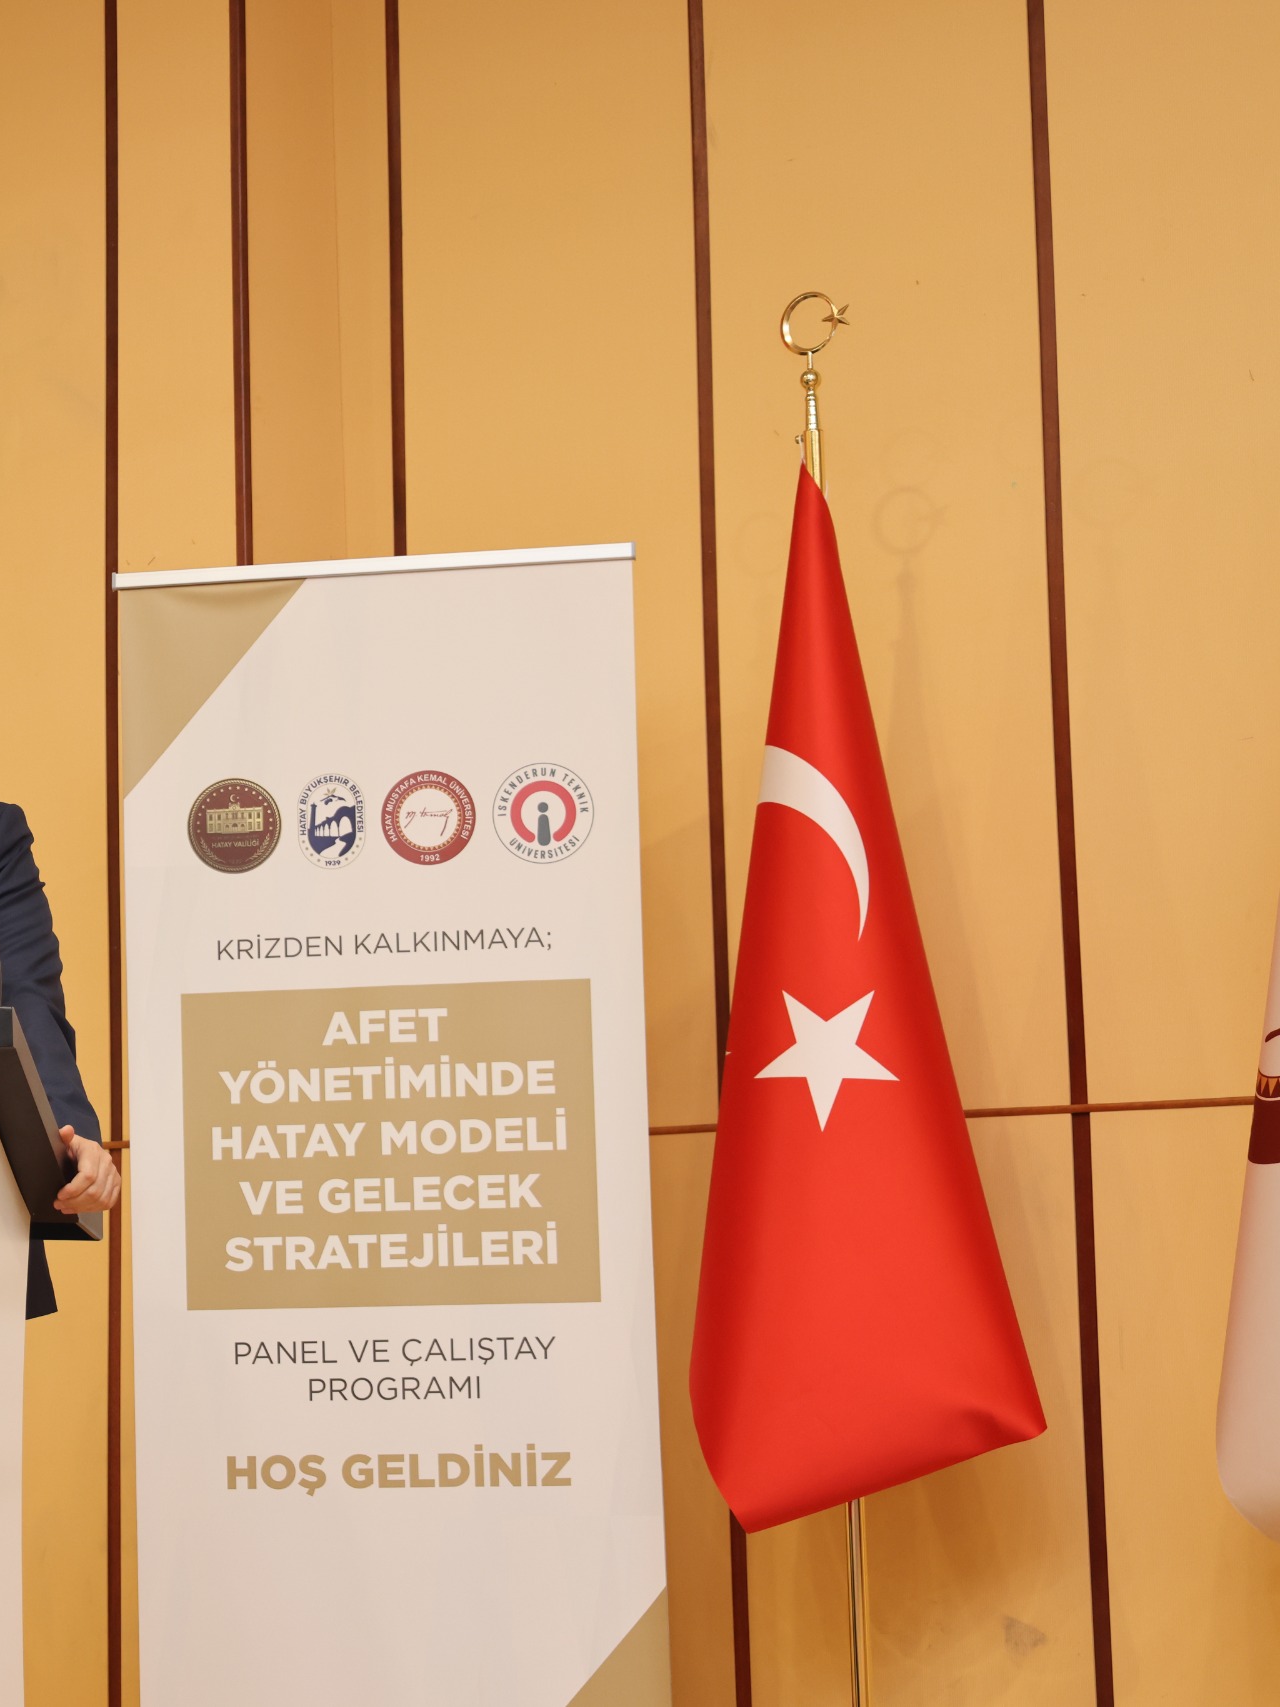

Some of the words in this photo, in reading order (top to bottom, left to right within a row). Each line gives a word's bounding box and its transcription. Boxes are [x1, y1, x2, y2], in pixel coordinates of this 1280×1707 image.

[385, 778, 416, 812] MUSTAFA
[416, 773, 447, 785] KEMAL
[299, 808, 307, 835] HATAY
[384, 813, 398, 842] HATAY
[419, 853, 440, 862] 1992
[217, 934, 343, 961] KRİZDEN
[353, 926, 553, 955] KALKINMAYA;
[322, 1007, 448, 1046] AFET
[218, 1055, 556, 1105] YÖNETİMİNDE
[211, 1122, 366, 1161] HATAY
[380, 1107, 567, 1156] MODELİ
[239, 1180, 304, 1215] VE
[318, 1173, 542, 1214] GELECEK
[224, 1221, 558, 1272] STRATEJİLERİ
[234, 1340, 337, 1365] PANEL
[348, 1339, 390, 1363] VE
[401, 1335, 556, 1366] ÇALIŞTAY
[308, 1375, 481, 1402] PROGRAMI
[226, 1454, 327, 1497] HOŞ
[341, 1443, 572, 1489] GELDİNİZ
